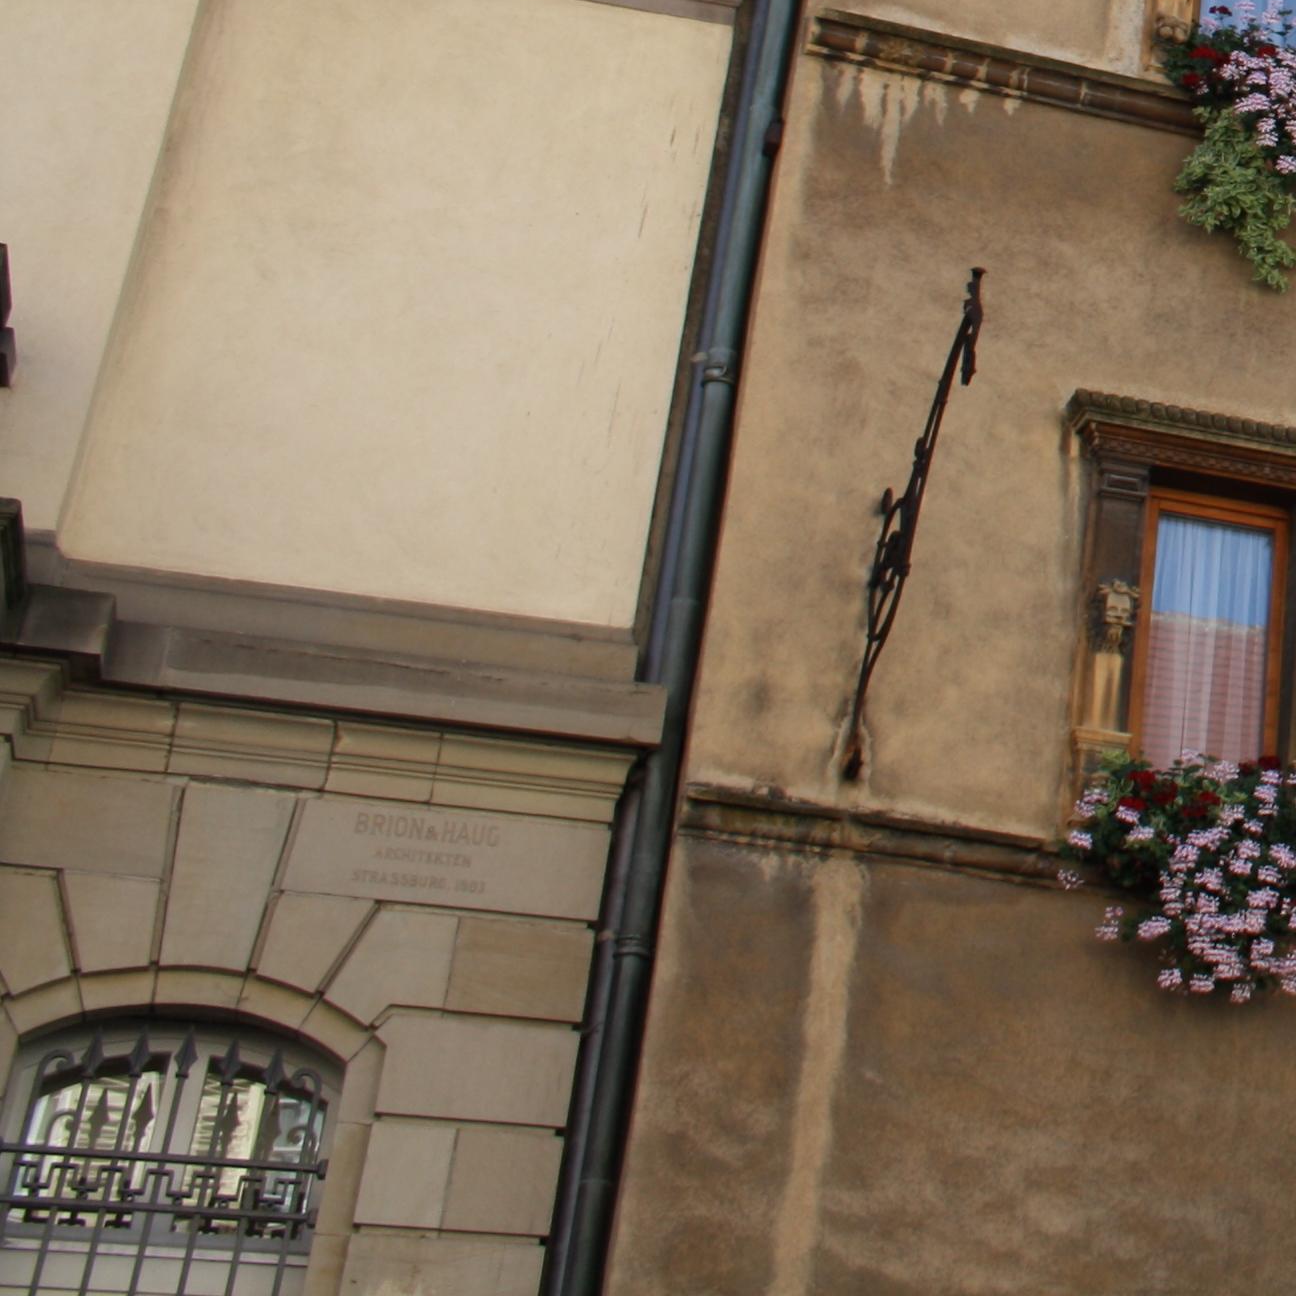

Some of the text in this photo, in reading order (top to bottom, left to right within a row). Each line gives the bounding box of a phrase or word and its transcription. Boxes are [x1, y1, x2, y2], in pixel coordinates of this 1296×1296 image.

[354, 812, 425, 839] BRION
[440, 819, 501, 847] HAUG
[372, 847, 472, 868] ARCHITEKTEN
